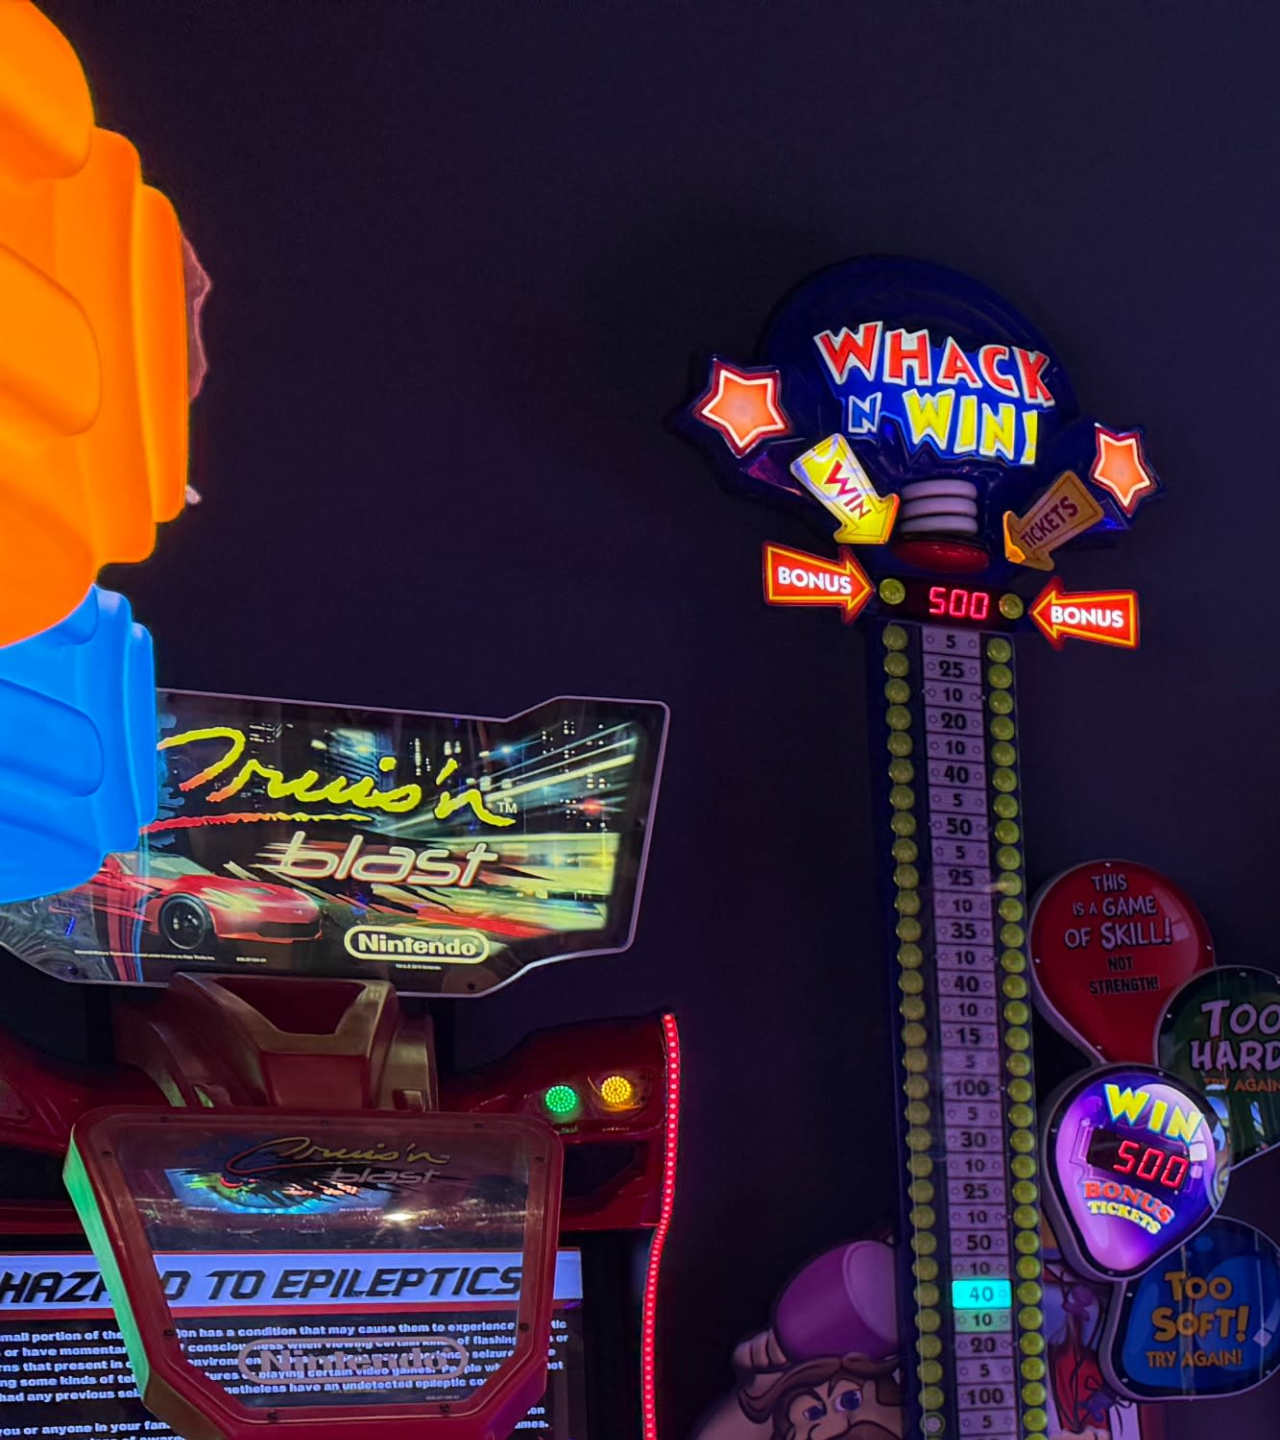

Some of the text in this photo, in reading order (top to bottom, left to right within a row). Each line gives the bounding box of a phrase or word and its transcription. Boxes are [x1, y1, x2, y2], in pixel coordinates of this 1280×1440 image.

[814, 321, 1054, 406] WHACK
[849, 389, 1038, 464] N WIN!
[824, 460, 872, 520] WIN
[1020, 496, 1079, 548] TICKETS
[778, 567, 852, 595] BONUS
[929, 587, 989, 619] 500
[1052, 606, 1124, 627] BONUS
[939, 662, 964, 679] 25
[944, 689, 962, 702] 10
[946, 740, 965, 754] 10
[944, 766, 969, 784] 40
[278, 832, 498, 886] blast
[1091, 874, 1127, 891] THIS
[953, 900, 972, 913] 10
[1073, 896, 1156, 917] IS A GAME
[1065, 918, 1172, 949] OF SKILL!
[358, 931, 476, 957] Nintendo
[955, 952, 975, 964] 10
[1108, 956, 1133, 971] NOT
[954, 976, 979, 992] 40
[1090, 976, 1159, 994] STRENGTH!
[958, 1004, 978, 1017] 10
[954, 1080, 989, 1096] 100
[1104, 1084, 1203, 1142] WIN
[226, 1137, 448, 1174] Cruis'n
[965, 1159, 985, 1172] 10
[1113, 1141, 1188, 1188] 500
[329, 1168, 440, 1184] blast
[963, 1183, 989, 1199] 25
[1084, 1181, 1175, 1224] BONUS
[967, 1210, 987, 1224] 10
[1088, 1201, 1161, 1235] TICKETS
[970, 1262, 990, 1275] 10
[0, 1266, 522, 1303] HAZD TO EPILEPTICS
[968, 1287, 995, 1302] 40
[973, 1314, 993, 1327] 10
[32, 1322, 514, 1343] portion condition that may cause them experience
[22, 1347, 57, 1356] have
[1147, 1351, 1242, 1367] TRY AGAIN!
[23, 1362, 52, 1372] that
[54, 1361, 108, 1373] present
[20, 1377, 57, 1387] some
[60, 1375, 97, 1385] kinds
[56, 1389, 115, 1401] previous
[290, 1383, 320, 1392] have
[343, 1379, 412, 1390] undetected
[416, 1378, 466, 1389] epileptic
[967, 1388, 1004, 1405] 100
[42, 1423, 141, 1436] anyone your
